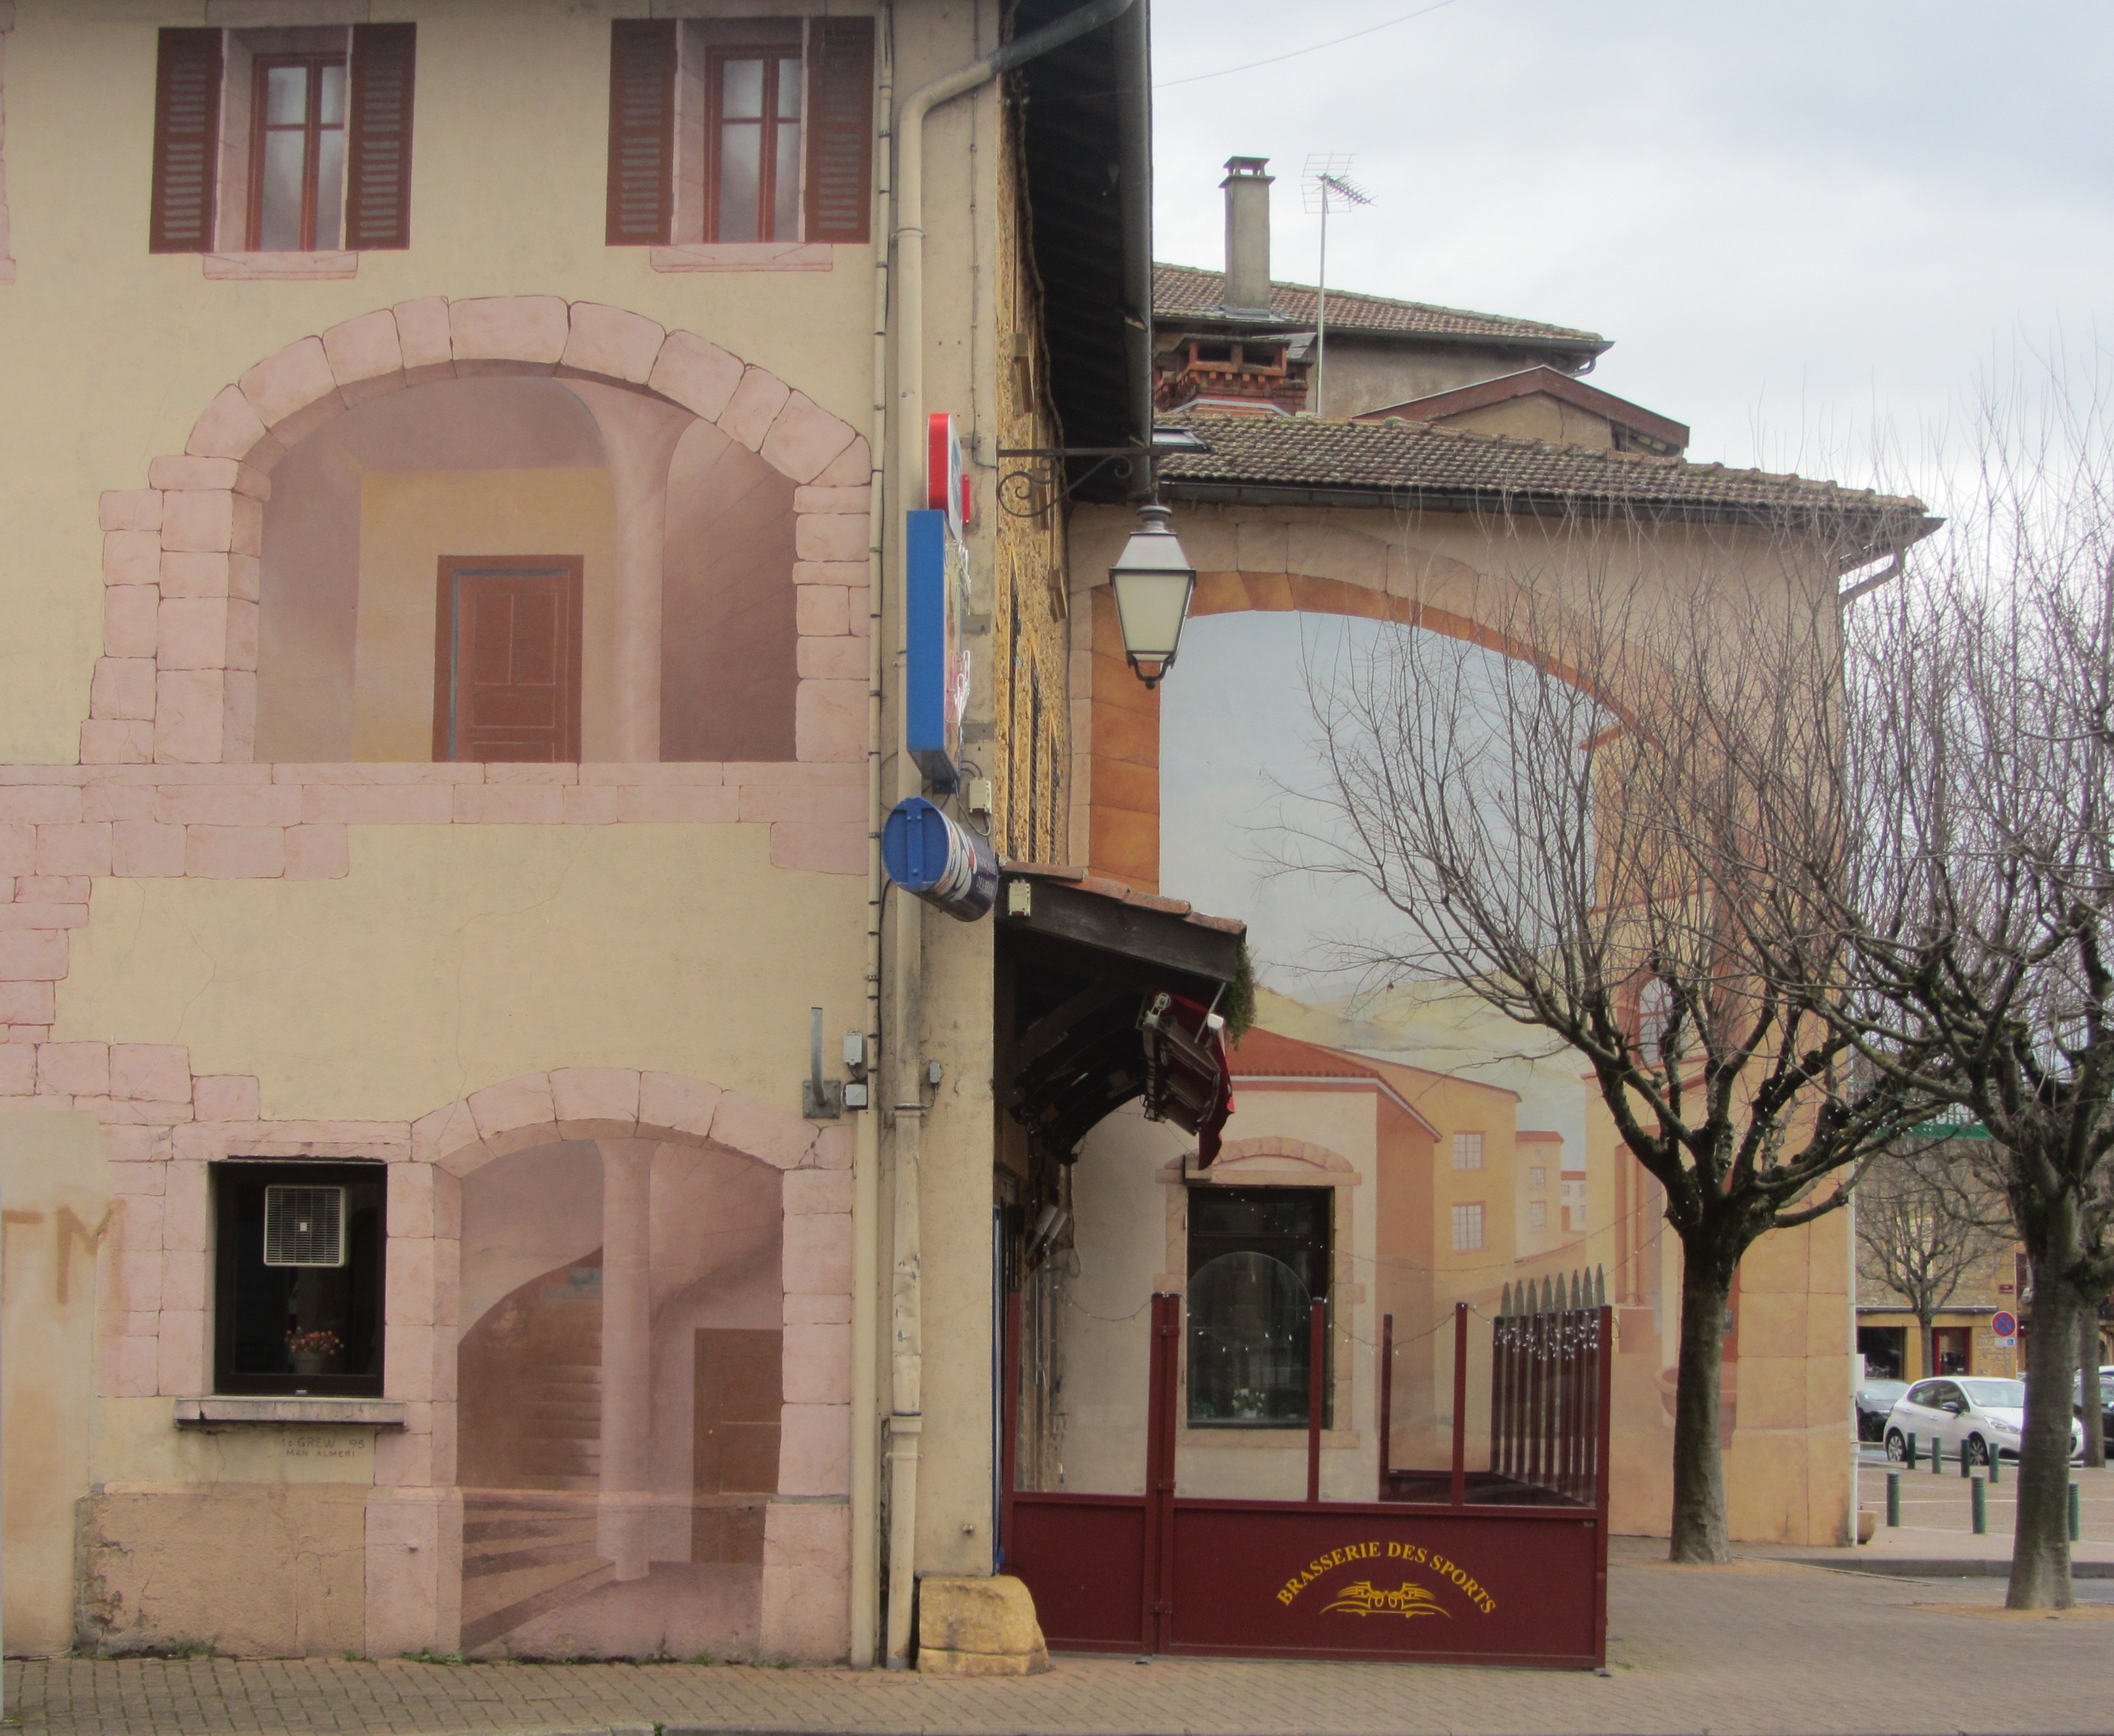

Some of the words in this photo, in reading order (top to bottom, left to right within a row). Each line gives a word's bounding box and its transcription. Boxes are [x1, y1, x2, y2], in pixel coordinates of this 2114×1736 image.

[1276, 1541, 1382, 1605] BRASSERIE
[1387, 1541, 1428, 1564] DES
[1429, 1554, 1497, 1614] SPORTS
